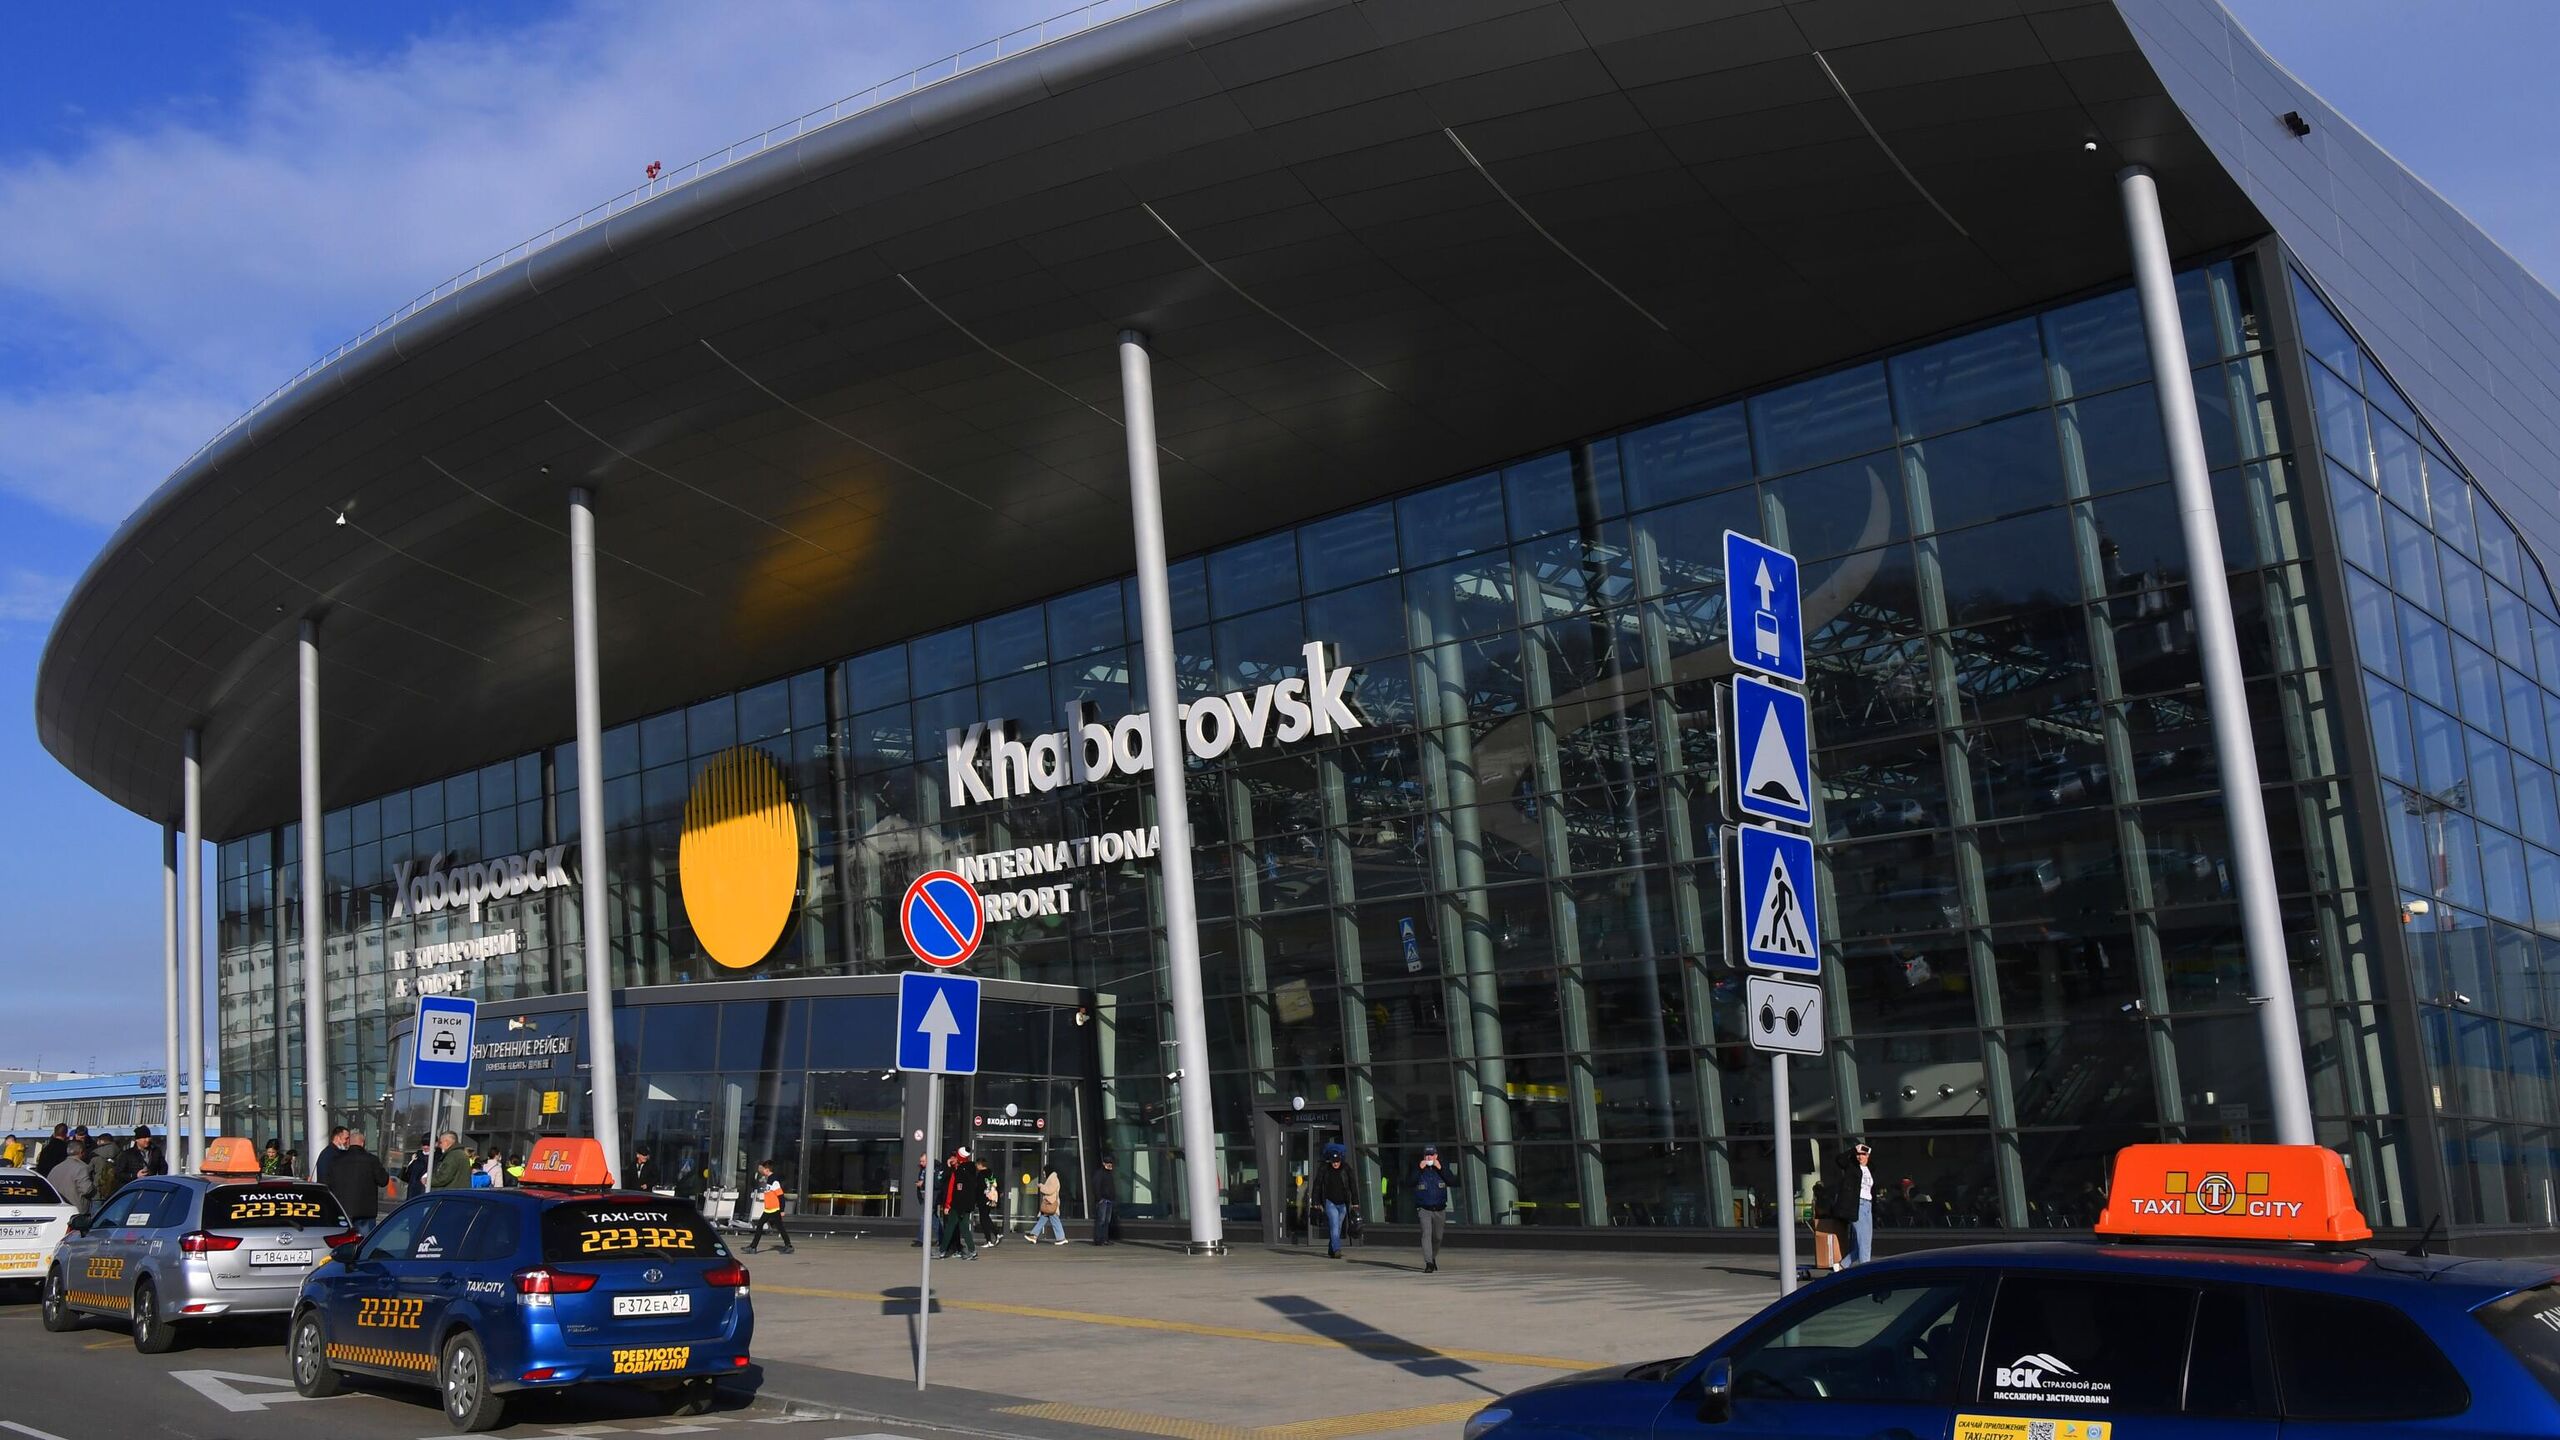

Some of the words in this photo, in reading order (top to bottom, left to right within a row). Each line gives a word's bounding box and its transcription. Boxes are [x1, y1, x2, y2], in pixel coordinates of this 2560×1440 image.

[946, 641, 1362, 808] Khabaovsk
[956, 825, 1161, 884] INTERNATIONA
[391, 844, 573, 924] Хабаровск
[979, 883, 1074, 923] RPORT
[533, 1034, 569, 1055] РЕЙСЫ
[987, 1117, 1008, 1126] ВХОДА
[1009, 1118, 1022, 1126] НЕТ
[239, 1193, 304, 1202] TAXI-CITY
[230, 1202, 321, 1220] 223-322
[2131, 1199, 2181, 1215] TAXI
[2249, 1200, 2303, 1218] CITY
[587, 1212, 668, 1223] TAXI-CITY
[580, 1228, 696, 1253] 223-322
[466, 1281, 505, 1293] TAXI-CITY
[612, 1347, 690, 1363] ТРЕБУЮТСЯ
[613, 1358, 687, 1374] ВОДИТЕЛИ
[1996, 1367, 2042, 1388] ВСК
[2042, 1380, 2090, 1390] СТРАХОВОЙ
[2091, 1382, 2111, 1391] ДОМ
[1994, 1391, 2045, 1402] ПАССАЖИРЫ
[2045, 1393, 2110, 1404] ЗАСТРАХОВАНЫ
[1958, 1420, 1983, 1429] СКАЧАЙ
[1983, 1422, 2027, 1431] ПРИЛОЖЕНИЕ
[1964, 1431, 2014, 1440] TAXI-CITY27
